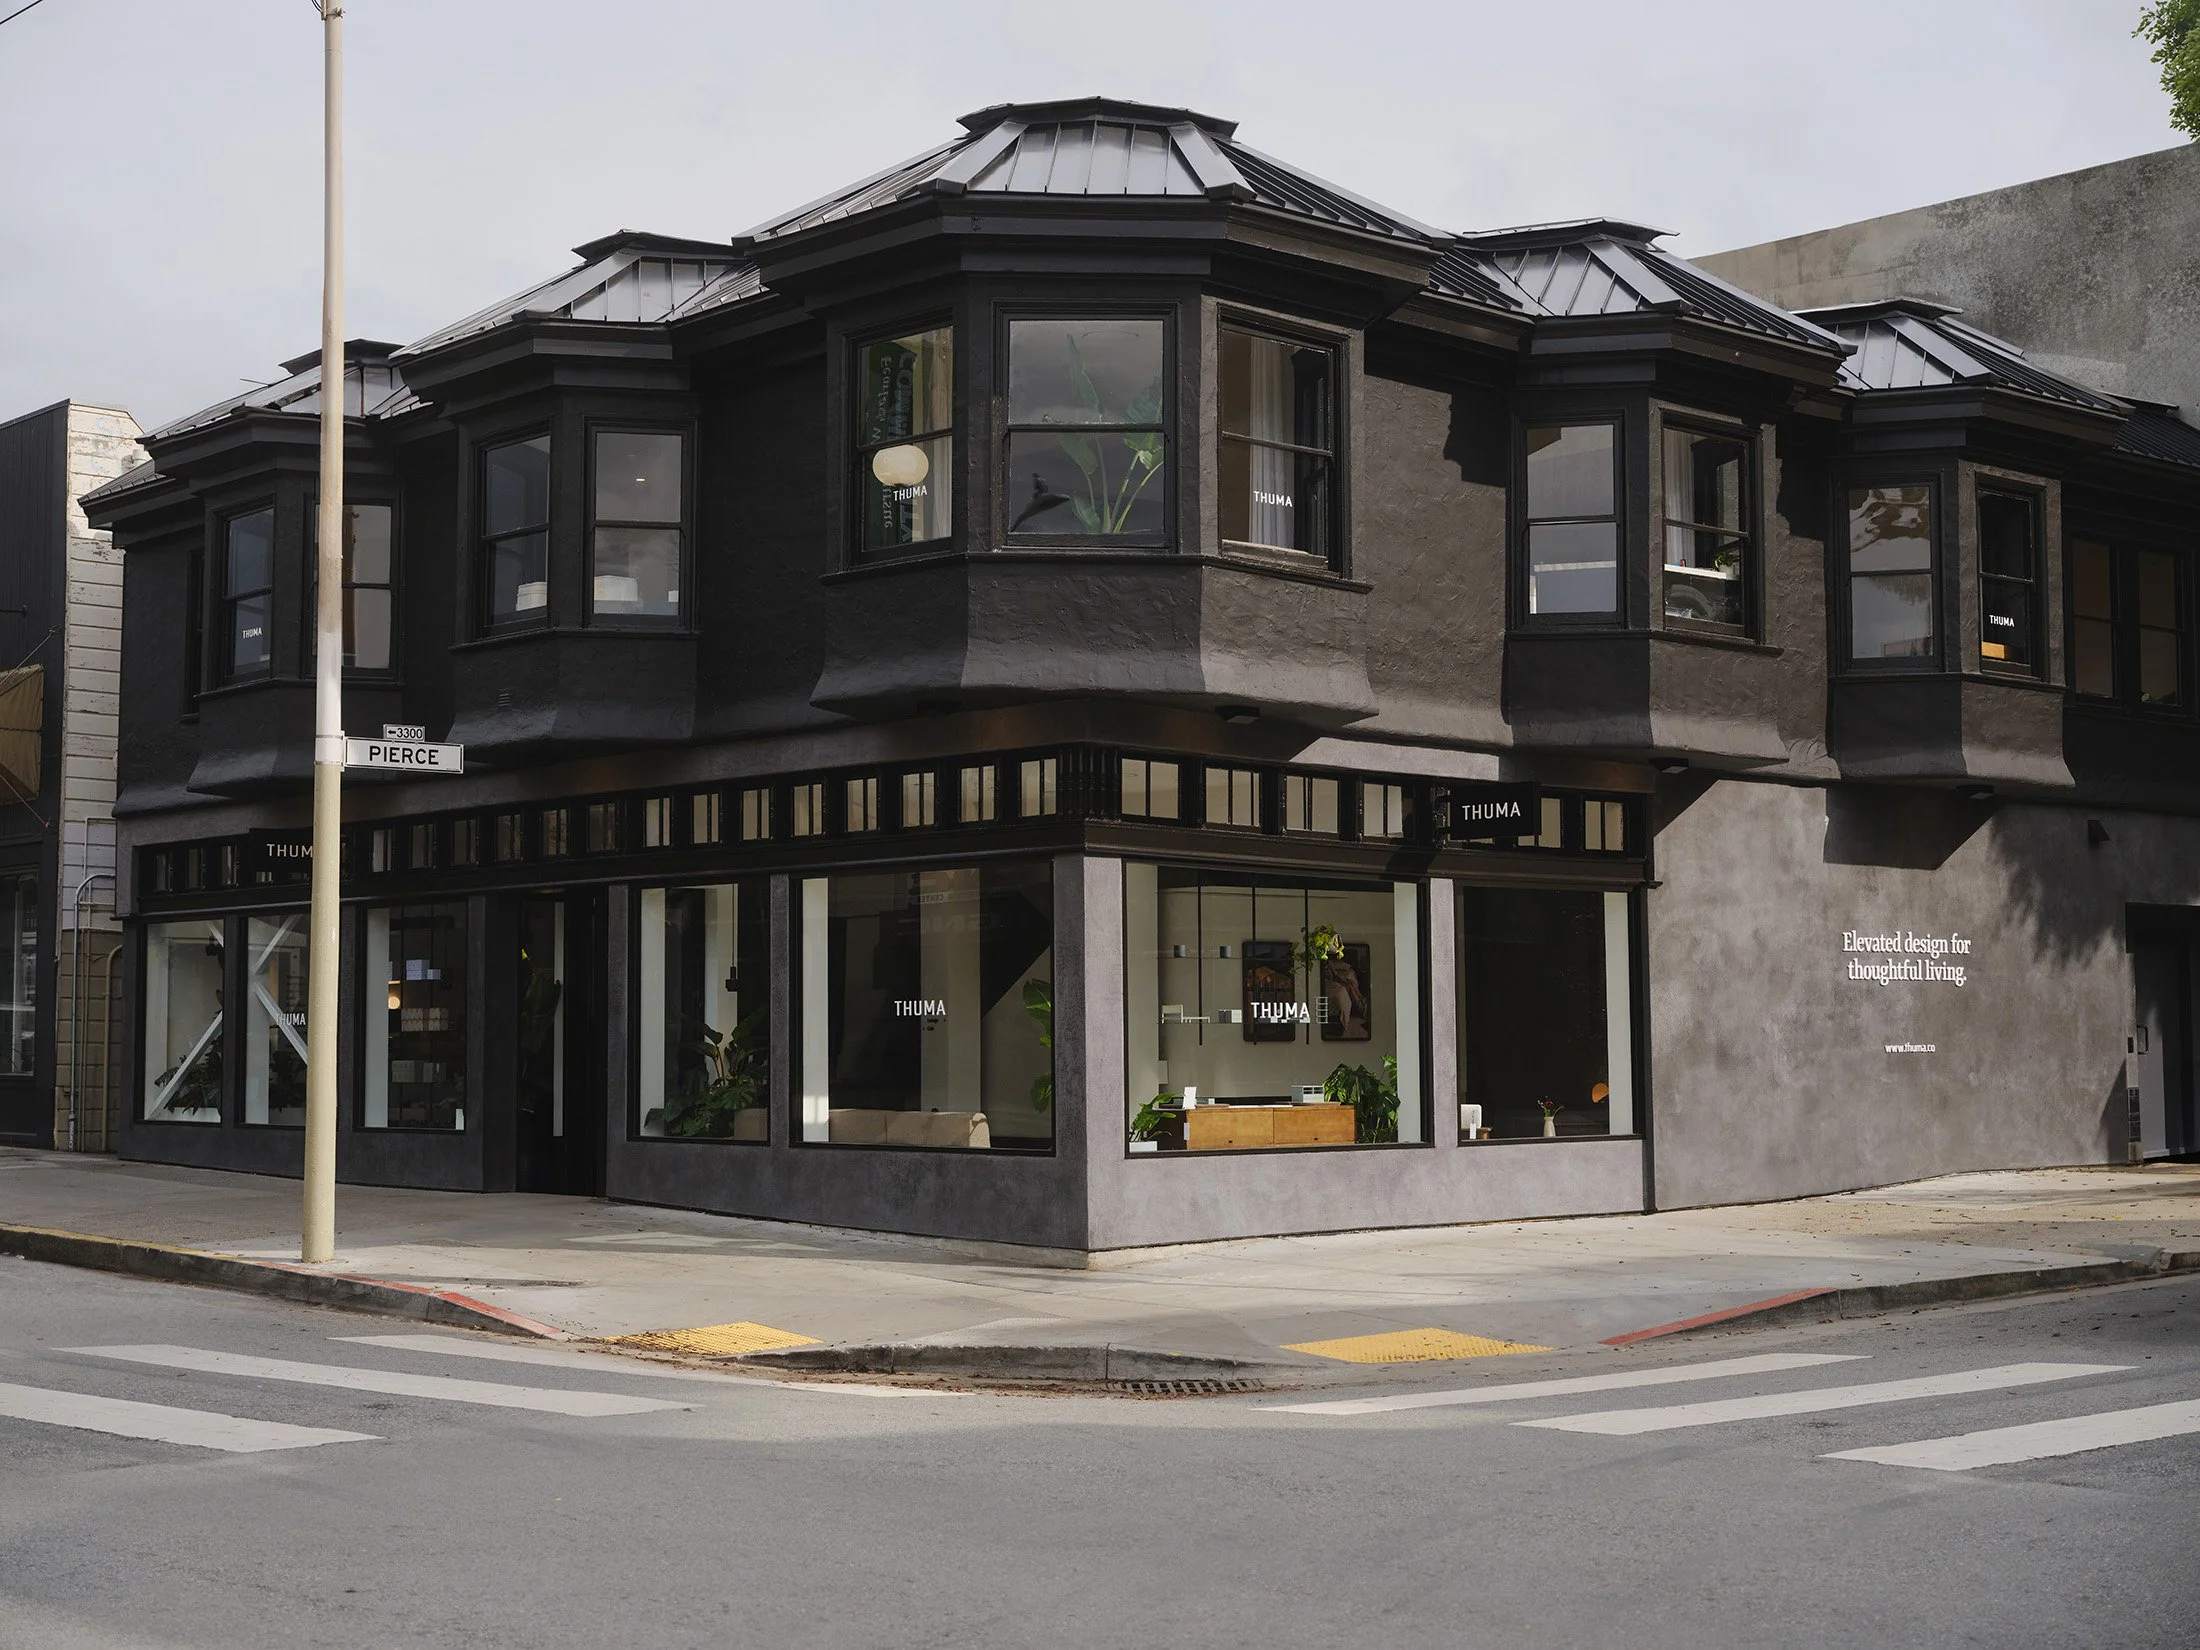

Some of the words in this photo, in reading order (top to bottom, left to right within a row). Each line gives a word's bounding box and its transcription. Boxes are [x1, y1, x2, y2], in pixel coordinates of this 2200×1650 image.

[893, 486, 928, 501] THUMA
[1254, 490, 1293, 507] THUMA
[1989, 614, 2015, 627] THUMA
[242, 627, 262, 639] THUMA
[397, 727, 423, 739] 3300
[369, 745, 439, 766] PIERCE
[1461, 801, 1522, 821] THUMA
[266, 843, 313, 858] THUM
[1842, 930, 1901, 952] Elevated
[1904, 931, 1949, 959] design
[1950, 933, 1972, 954] for
[1848, 958, 1923, 986] thoughtful
[1925, 960, 1967, 987] living.
[894, 999, 947, 1017] THUMA
[1250, 1002, 1310, 1019] THUMA
[276, 1013, 306, 1026] THUMA
[1884, 1042, 1936, 1053] www.thuma.co
